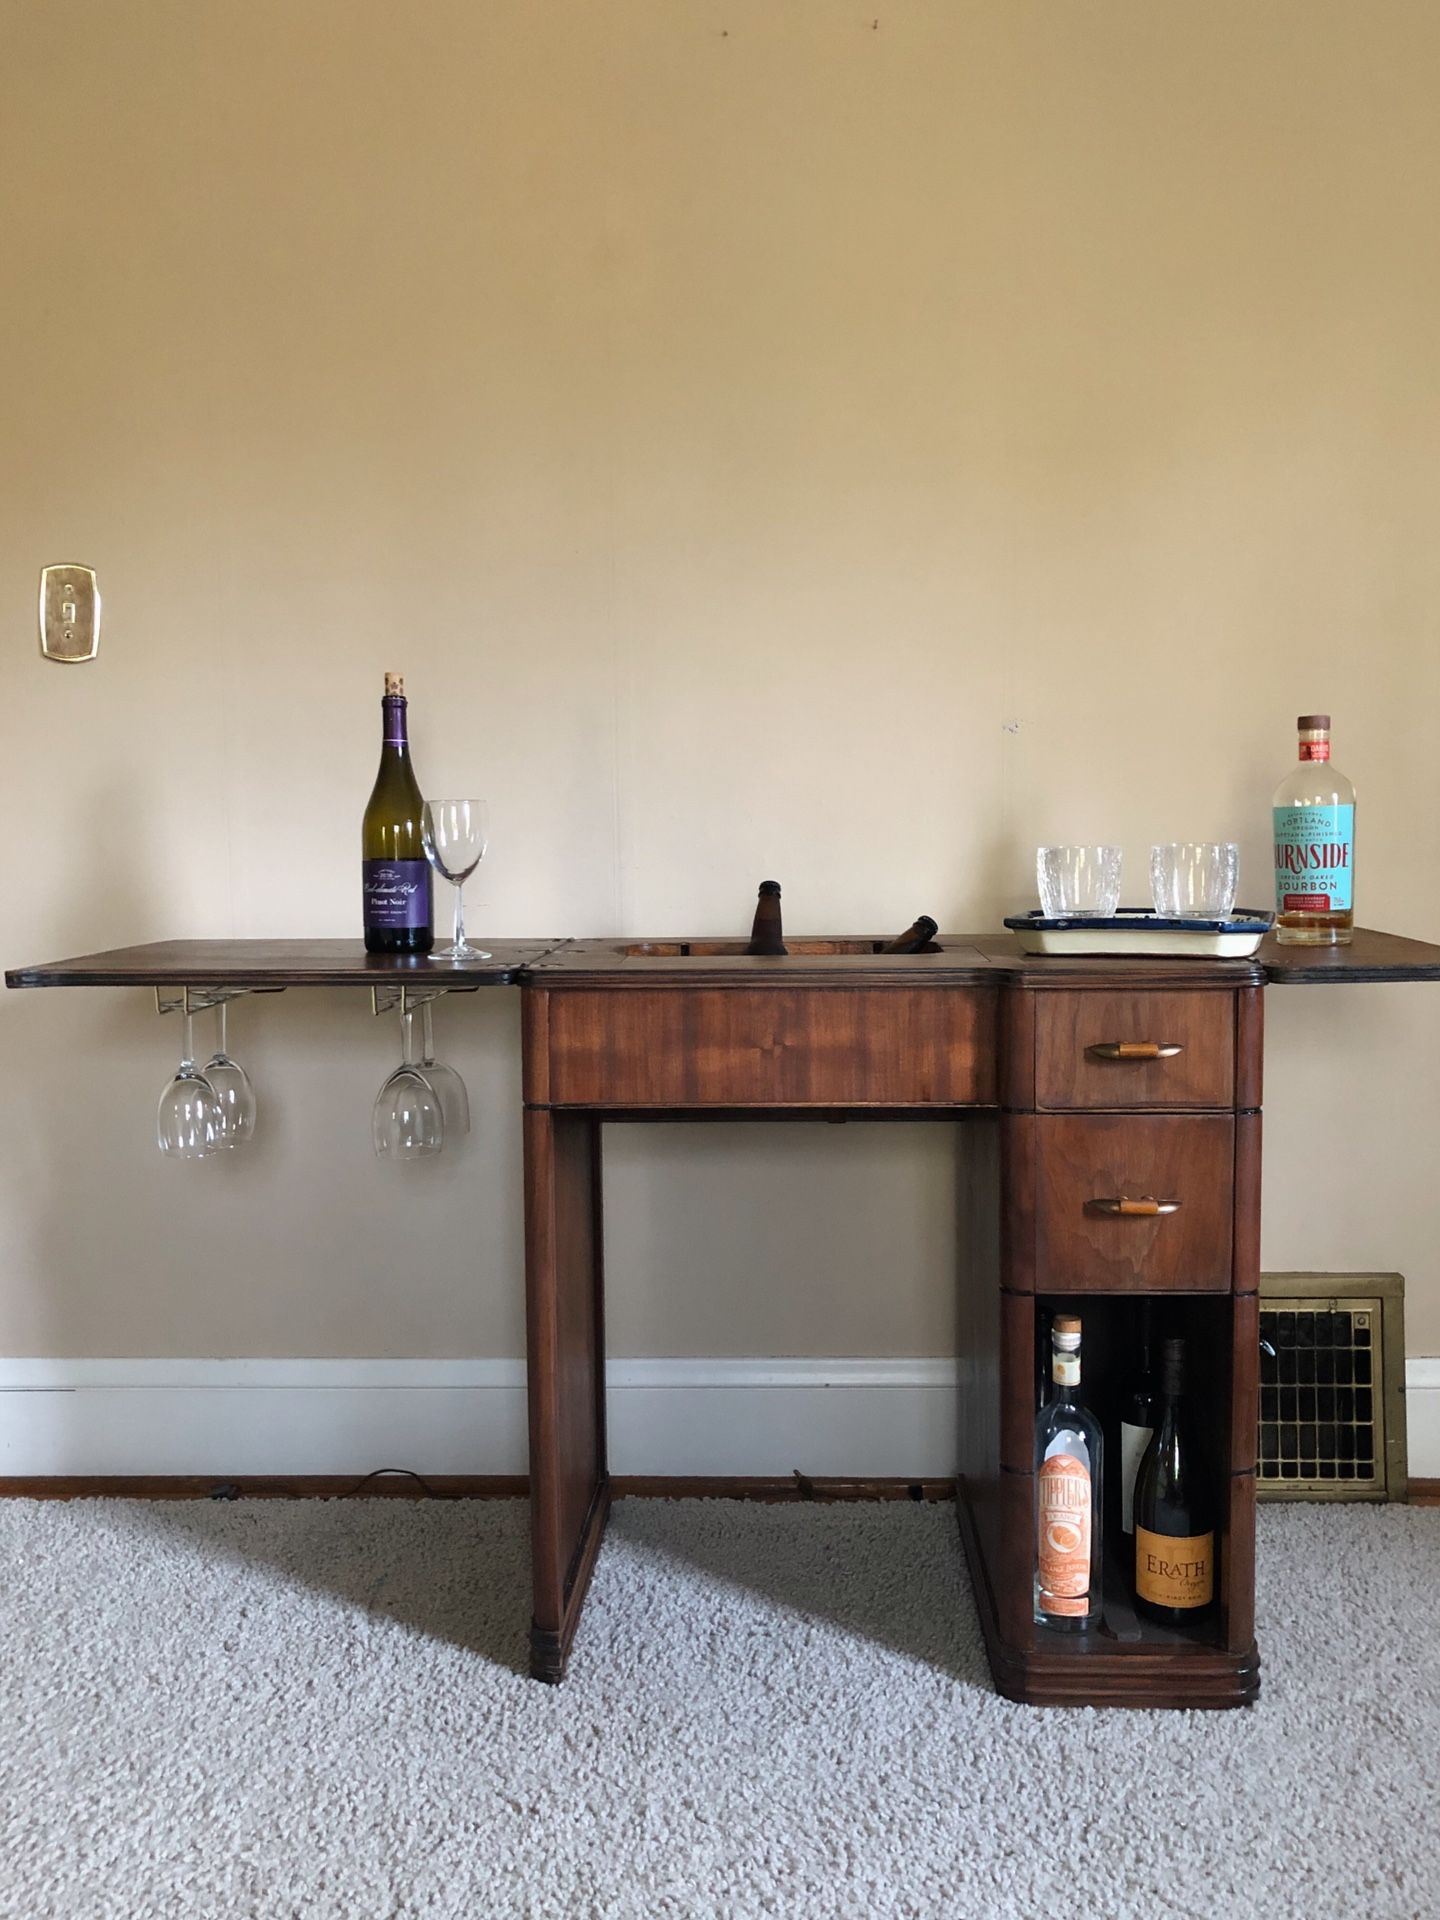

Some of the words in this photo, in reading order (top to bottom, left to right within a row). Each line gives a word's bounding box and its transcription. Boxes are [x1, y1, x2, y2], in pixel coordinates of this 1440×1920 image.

[1282, 816, 1332, 828] PORTLAND
[1279, 881, 1338, 891] BOURBON
[1146, 1553, 1206, 1579] ERATH
